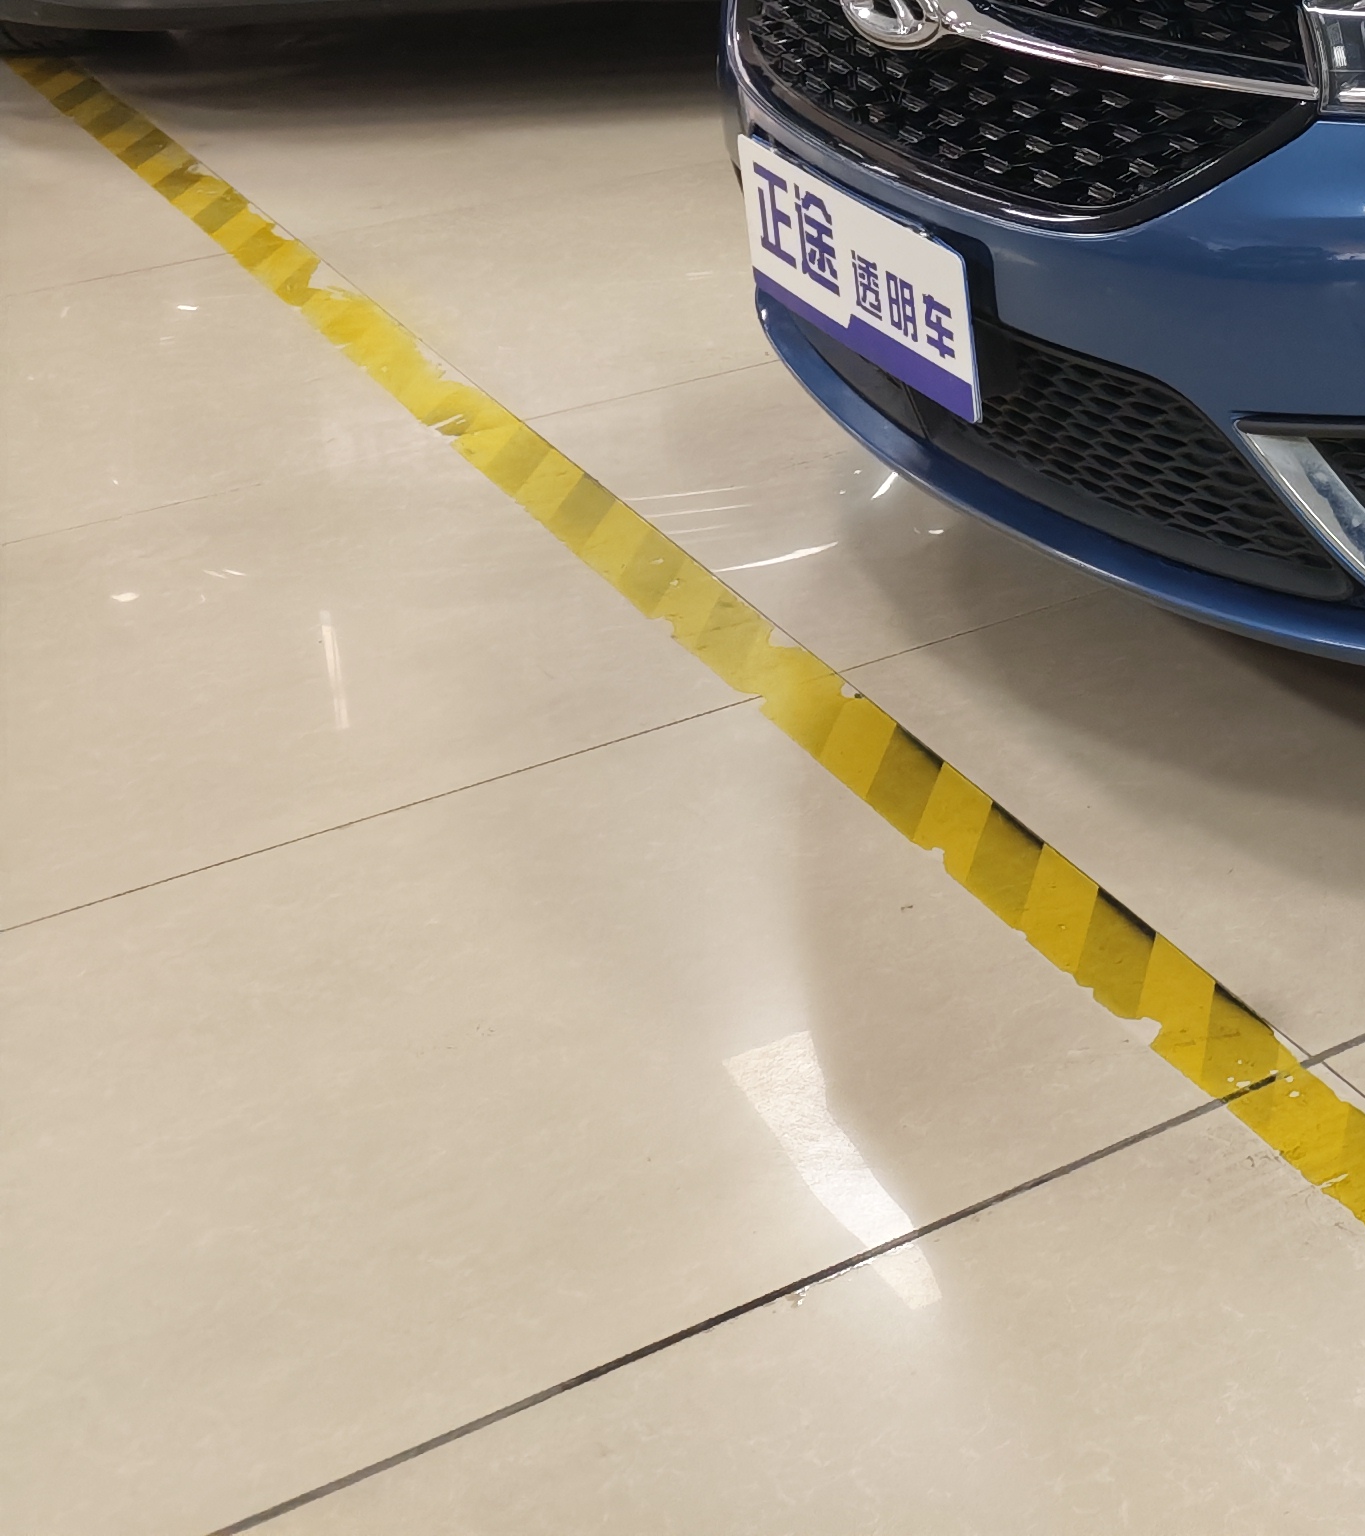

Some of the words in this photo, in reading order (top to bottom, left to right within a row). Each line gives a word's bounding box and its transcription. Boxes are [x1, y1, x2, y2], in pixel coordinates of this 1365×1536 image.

[753, 160, 841, 298] 正途
[851, 249, 956, 360] 透明车
